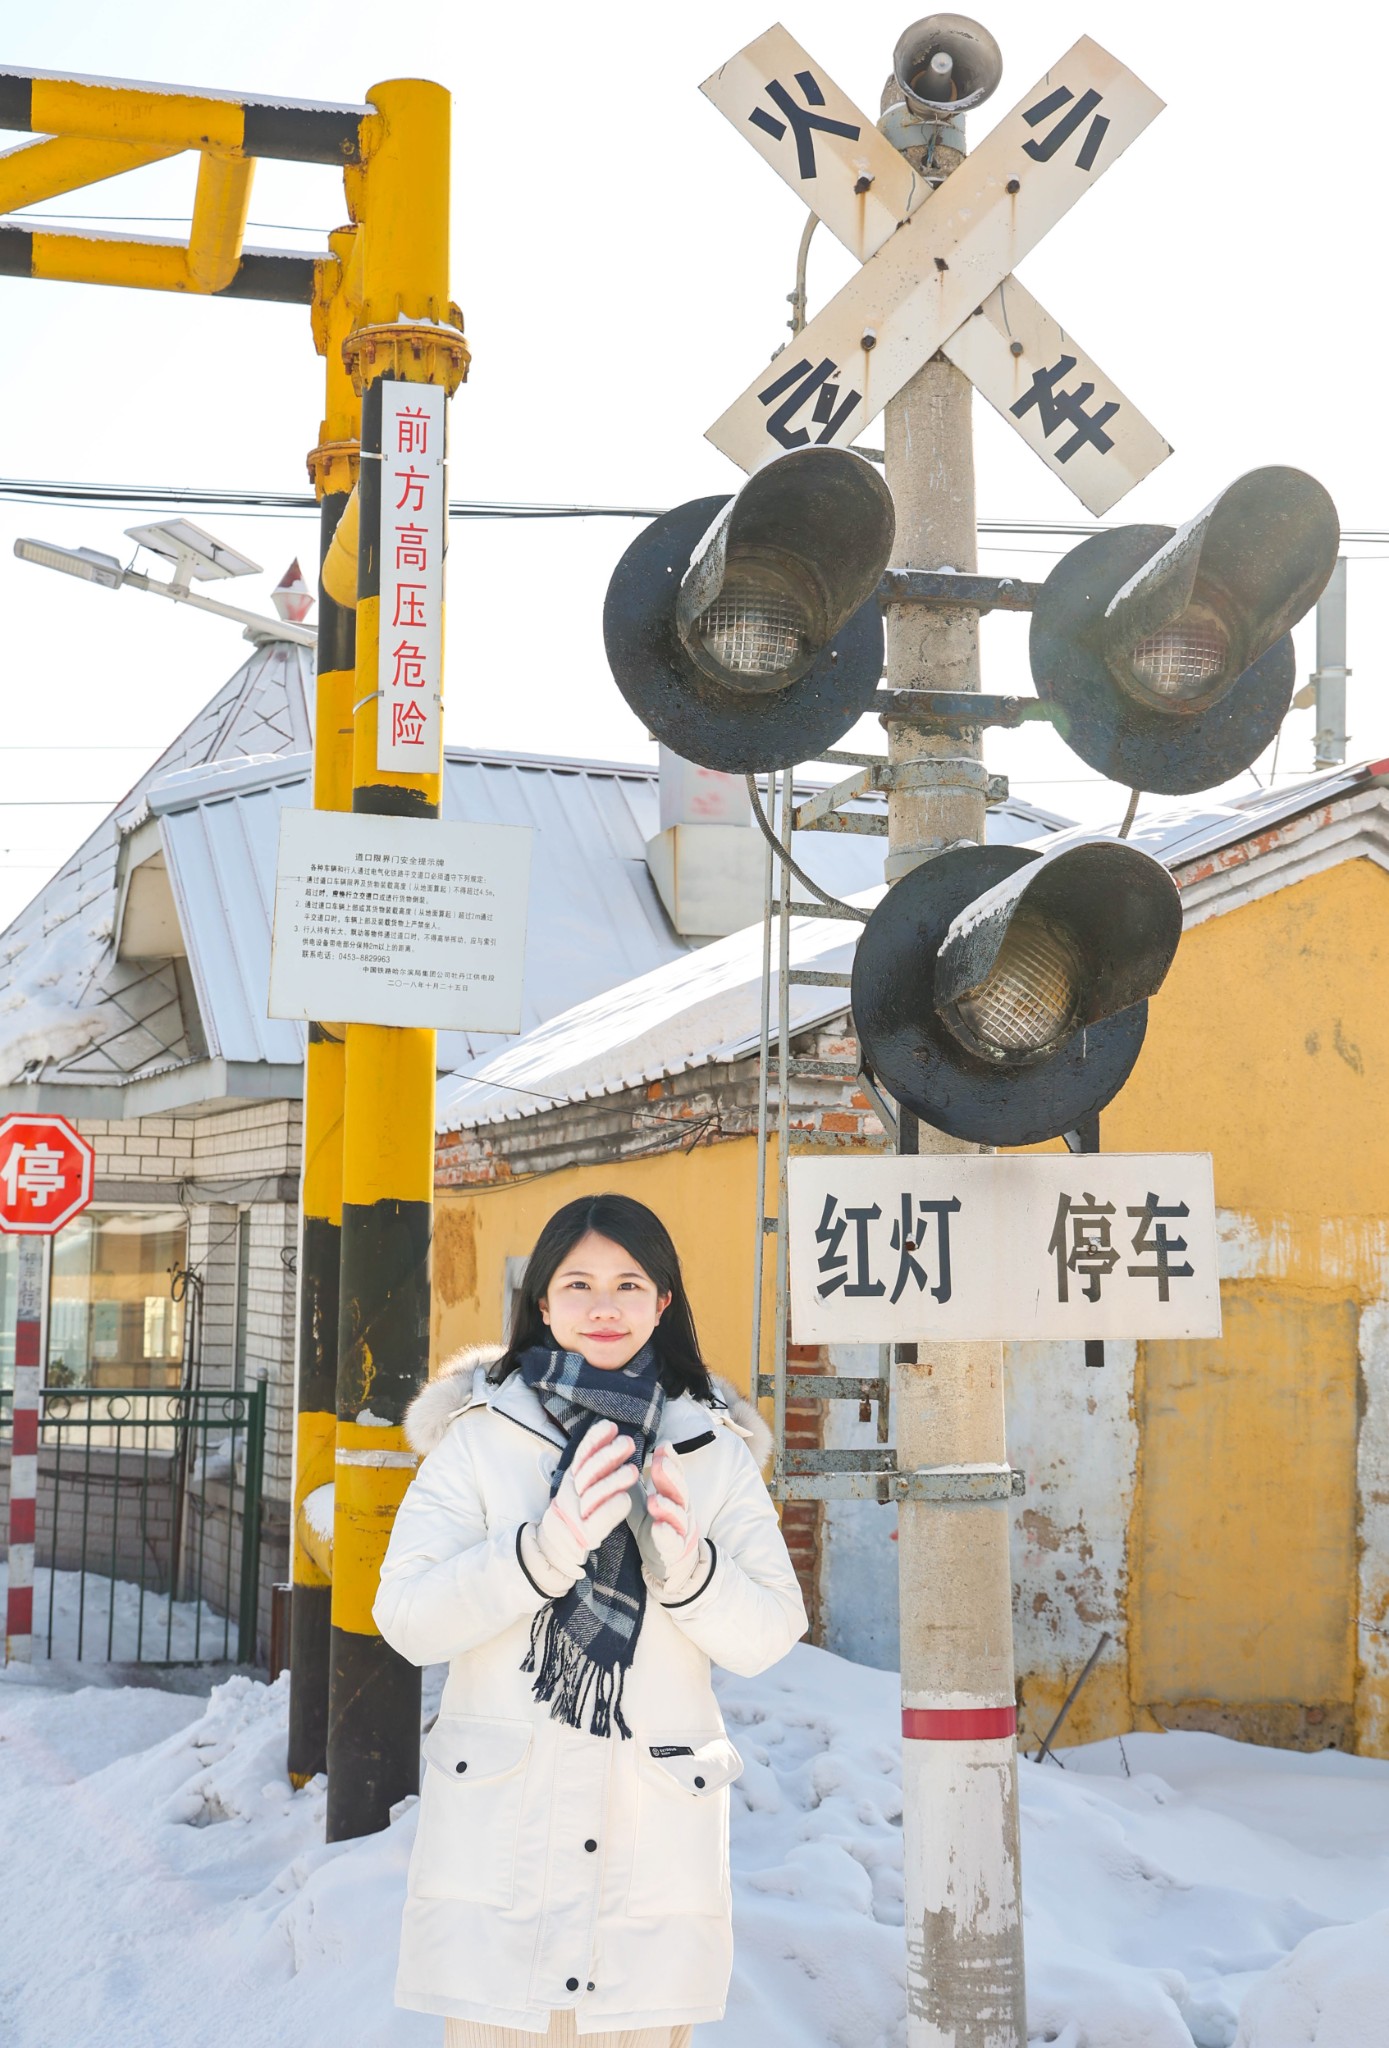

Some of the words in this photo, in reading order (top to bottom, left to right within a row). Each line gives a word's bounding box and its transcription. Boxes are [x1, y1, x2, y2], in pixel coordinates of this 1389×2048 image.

[1022, 86, 1110, 172] 小
[749, 71, 861, 180] 火
[1010, 355, 1120, 464] 车
[757, 357, 863, 450] 心
[391, 406, 431, 747] 前方高压危险
[355, 853, 445, 867] 道口限界门安全提示牌
[0, 1142, 65, 1207] 停
[815, 1193, 962, 1305] 红灯
[1048, 1192, 1195, 1303] 停车
